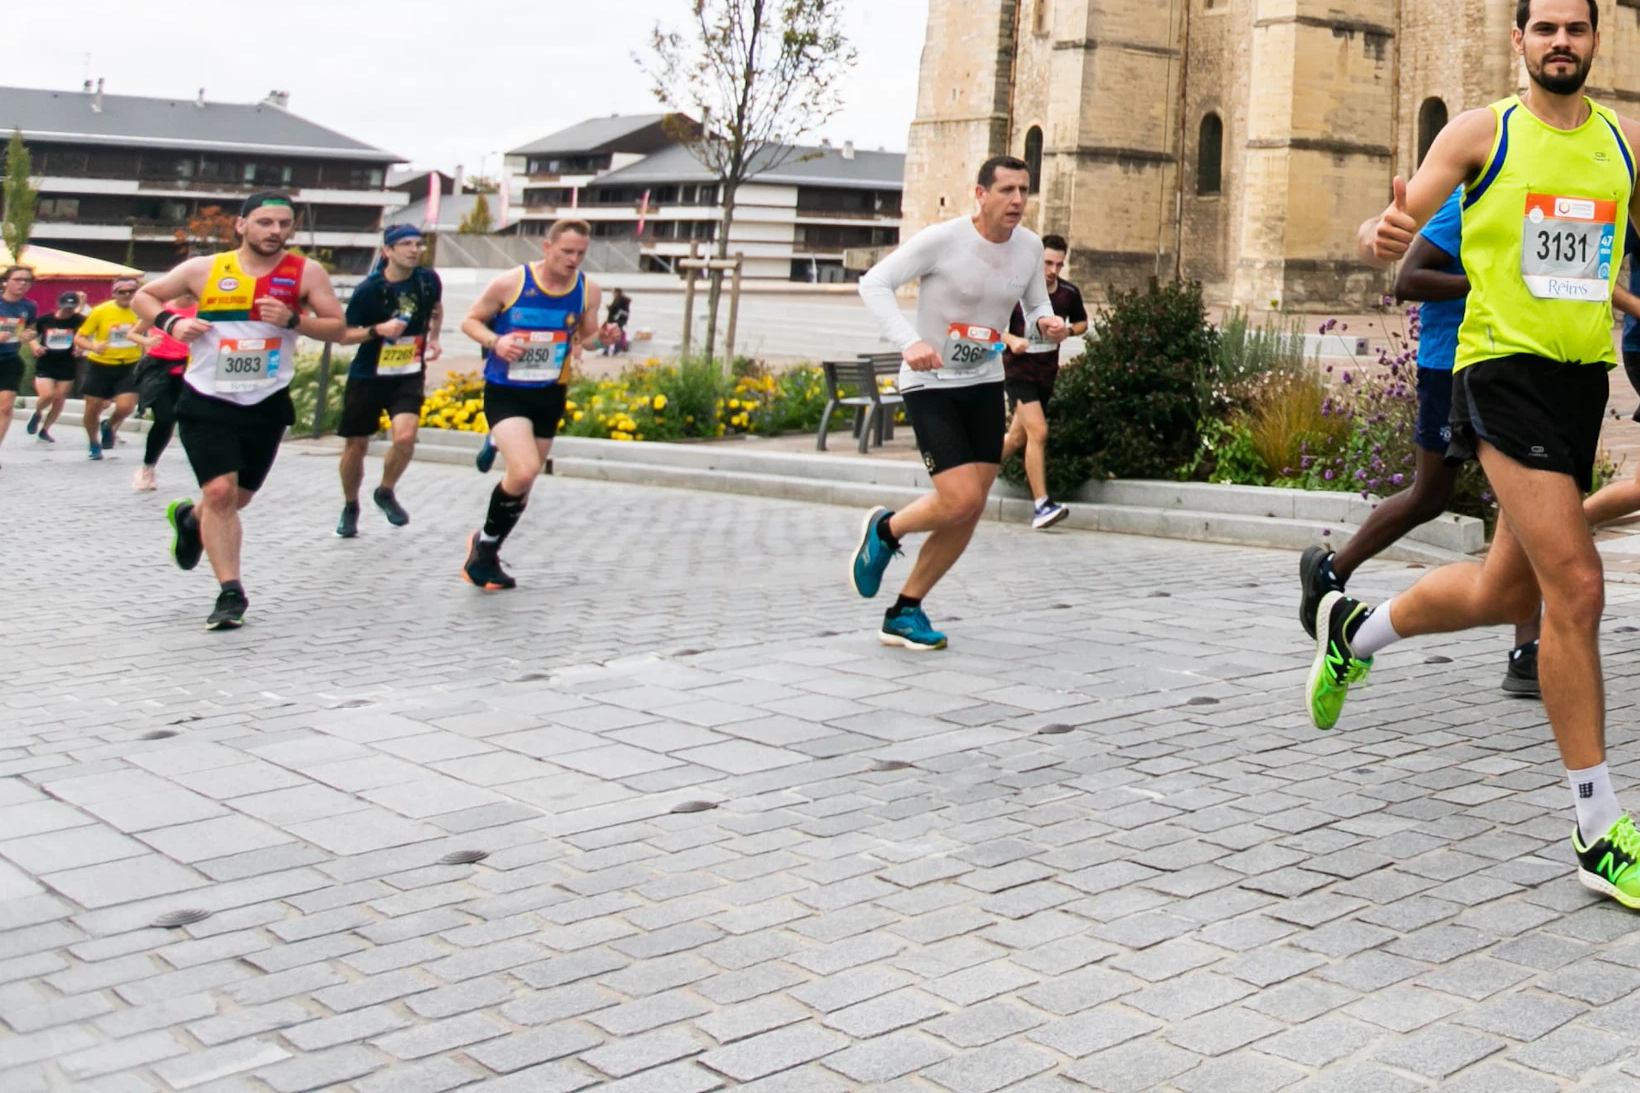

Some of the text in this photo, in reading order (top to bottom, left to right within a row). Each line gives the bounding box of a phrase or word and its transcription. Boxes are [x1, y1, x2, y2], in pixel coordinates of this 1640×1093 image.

[1536, 230, 1587, 263] 3131
[1601, 235, 1613, 247] 47
[1548, 278, 1588, 296] Reims
[225, 357, 261, 373] 3083
[1596, 850, 1629, 883] N
